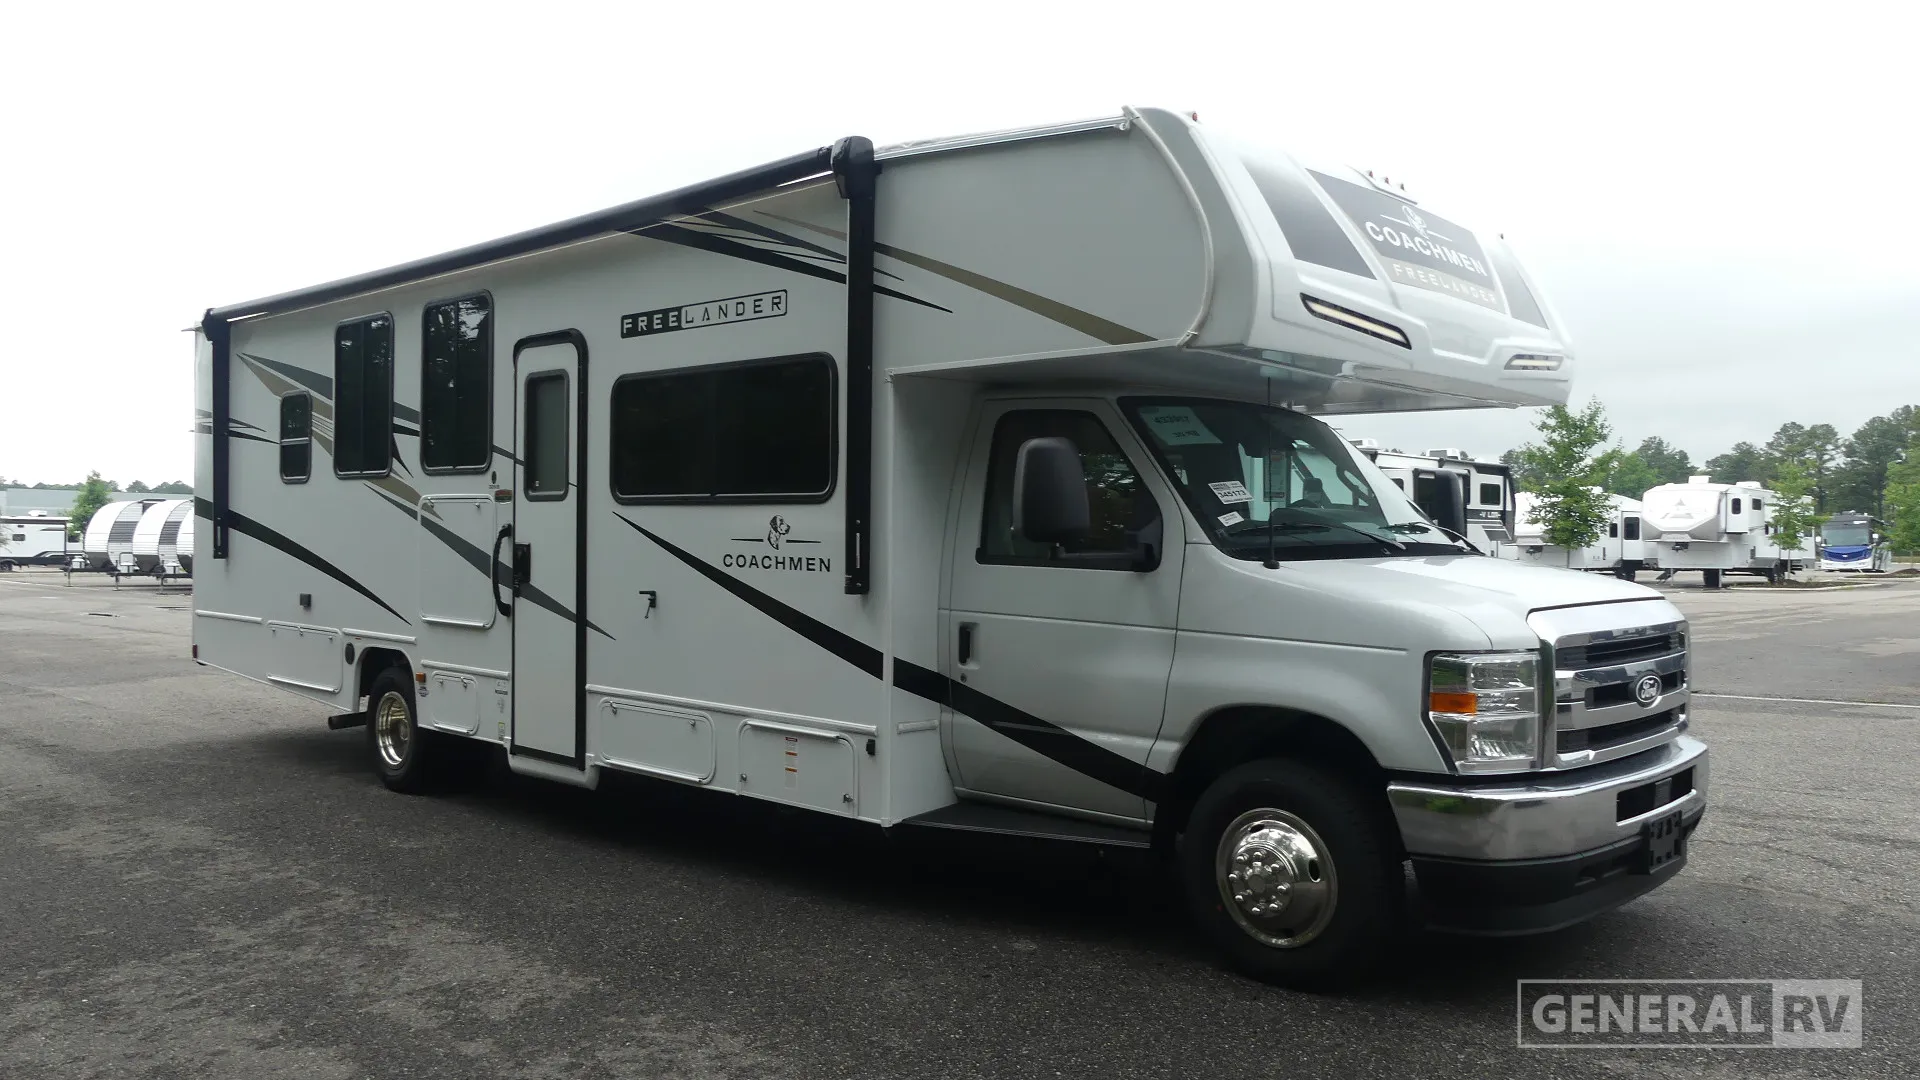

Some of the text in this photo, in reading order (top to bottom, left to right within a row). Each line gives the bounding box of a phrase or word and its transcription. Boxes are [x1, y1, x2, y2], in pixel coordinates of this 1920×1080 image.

[1365, 221, 1488, 277] COACHMEN
[1391, 263, 1497, 304] FREELANDER
[622, 295, 782, 334] FREELANDER
[1218, 490, 1247, 499] 345173
[723, 553, 831, 573] COACHMEN
